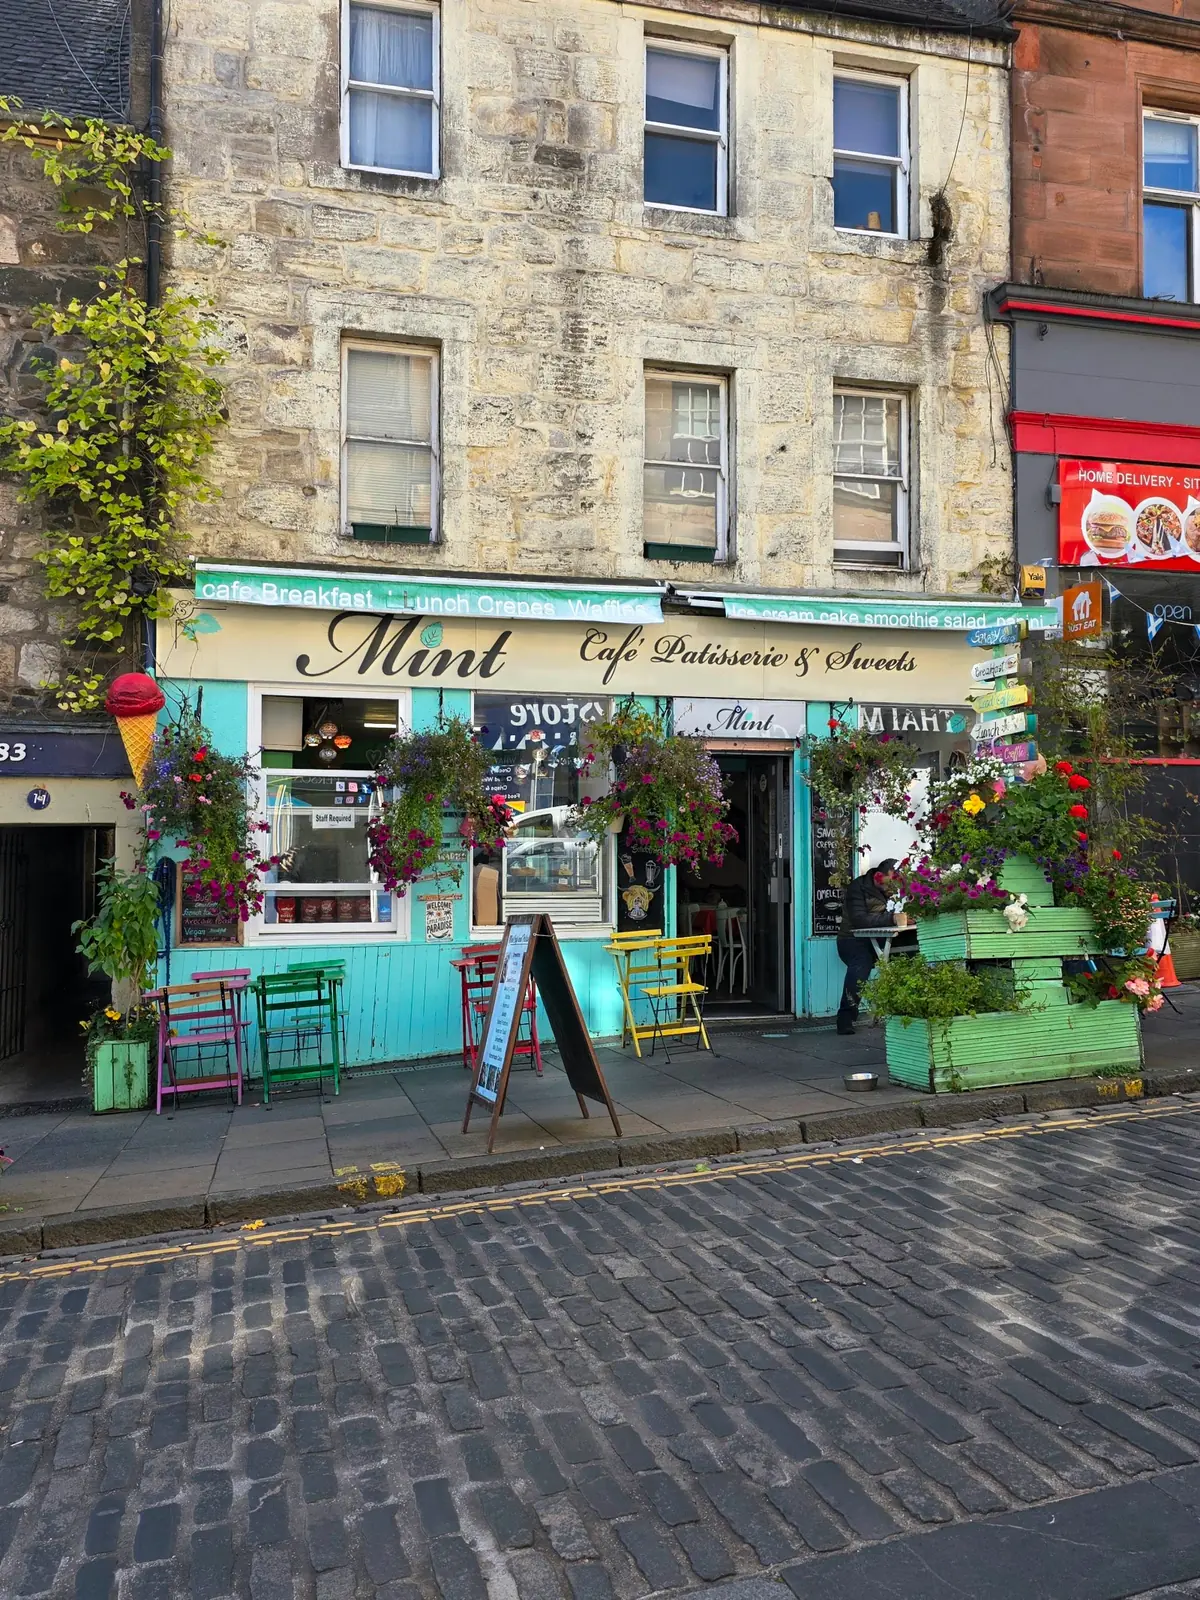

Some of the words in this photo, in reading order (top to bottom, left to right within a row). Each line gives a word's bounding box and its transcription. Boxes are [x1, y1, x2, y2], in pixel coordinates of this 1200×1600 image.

[1078, 470, 1113, 484] HOME
[1116, 473, 1173, 487] DELIVERY
[1028, 572, 1044, 581] Yale
[202, 580, 252, 600] cafe
[261, 582, 373, 608] Breakfast
[403, 590, 469, 612] Lunch
[477, 595, 555, 618] Crepes
[567, 598, 647, 618] Waffles
[819, 609, 859, 624] cake
[864, 611, 939, 628] smoothie
[943, 613, 987, 628] salad
[1153, 603, 1192, 622] open
[1068, 622, 1082, 633] JUST
[1083, 619, 1097, 630] EAT
[296, 612, 513, 679] Mint
[580, 625, 643, 685] Café
[651, 634, 788, 668] Patisserie
[794, 646, 820, 677] &
[826, 641, 918, 675] Sweets
[706, 707, 775, 732] Mint
[976, 722, 1000, 740] Lunch
[0, 742, 26, 762] 83
[315, 814, 328, 822] Staff
[329, 814, 352, 823] Required
[816, 827, 847, 839] SAVOY
[426, 901, 452, 910] WELCOME
[426, 920, 453, 934] PARADISE
